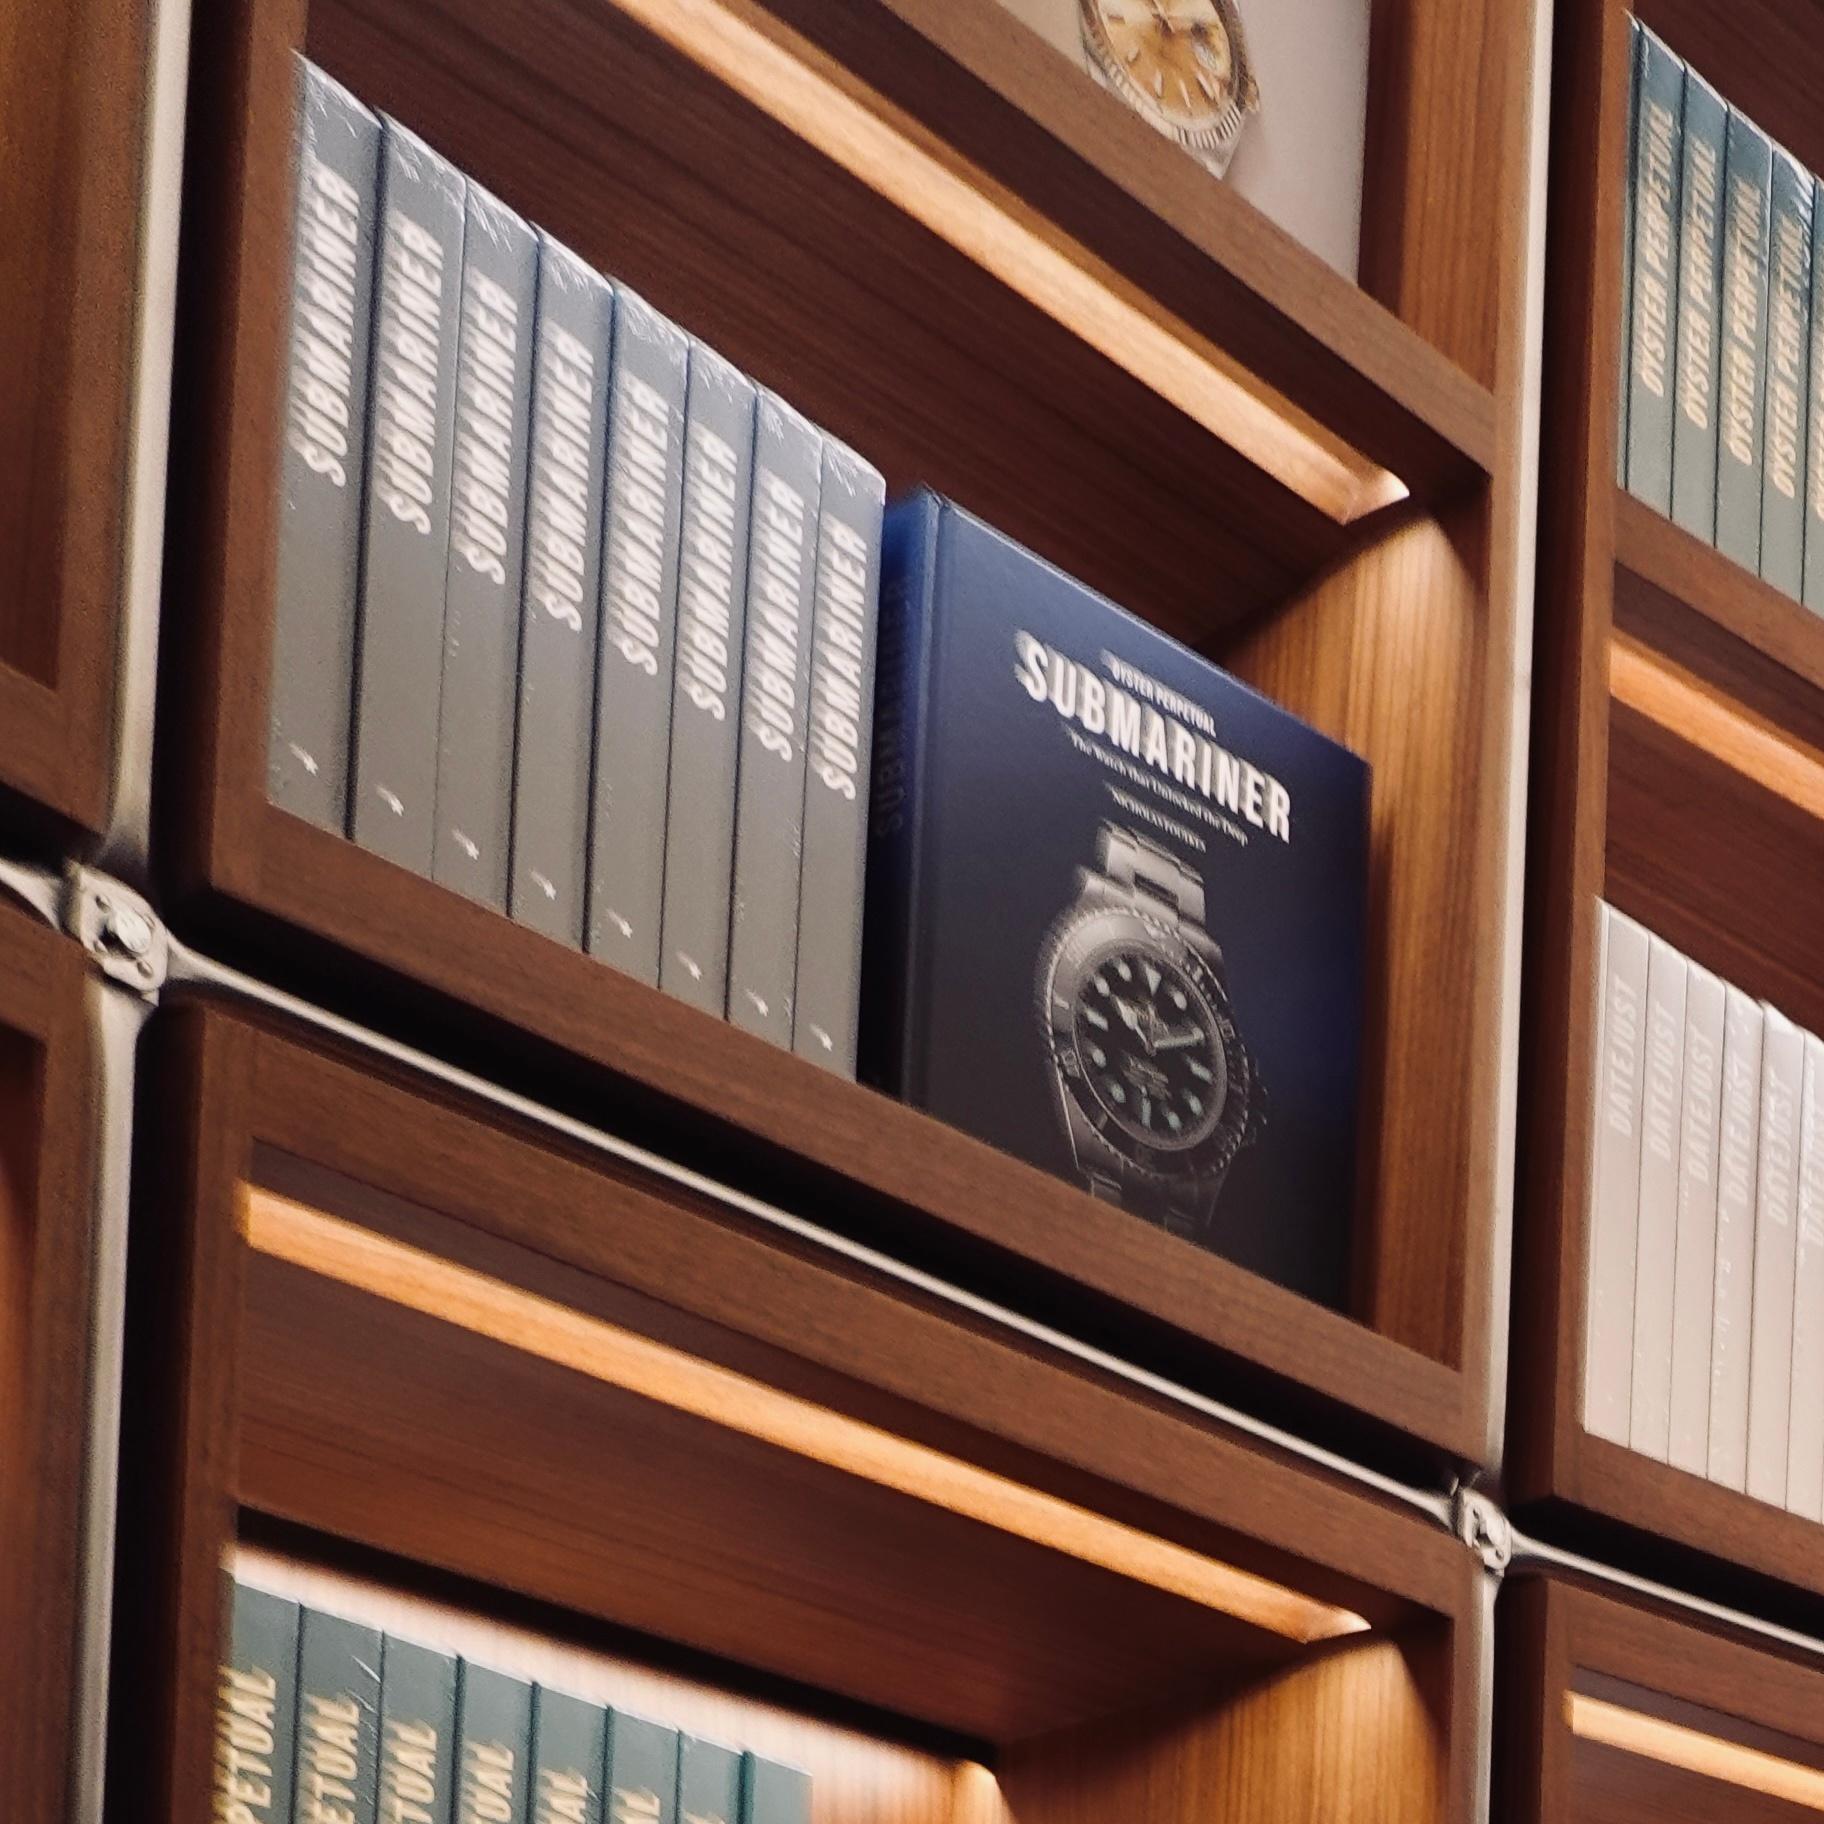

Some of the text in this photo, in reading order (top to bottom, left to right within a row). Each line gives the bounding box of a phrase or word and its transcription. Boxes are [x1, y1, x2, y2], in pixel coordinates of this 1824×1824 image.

[288, 158, 360, 487] SUBMARINER
[374, 207, 444, 535] SUBMARINER
[1640, 102, 1672, 398] OYSTER PERPETUAL
[1683, 137, 1716, 431] OYSTER PERPETUAL
[1727, 174, 1761, 466] OYSTER PERPETUAL
[1770, 213, 1803, 498] OYSTER PERPETUAL
[452, 266, 518, 584] SUBMARINER
[527, 316, 595, 633] SUBMARINER
[606, 369, 670, 676] SUBMARINER
[680, 420, 738, 720] SUBMARINER
[749, 467, 805, 762] SUBMARINER
[812, 509, 867, 800] SUBMARINER
[1014, 629, 1290, 844] SUBMARINER
[1102, 648, 1216, 738] OYSTER PERPETUAL
[1607, 974, 1638, 1136] DATEJUST
[1648, 998, 1678, 1161] DATEJUST
[1686, 1022, 1716, 1185] DATEJUST
[1723, 1044, 1752, 1206] DATEJUST
[1762, 1068, 1794, 1227] DATEJUST
